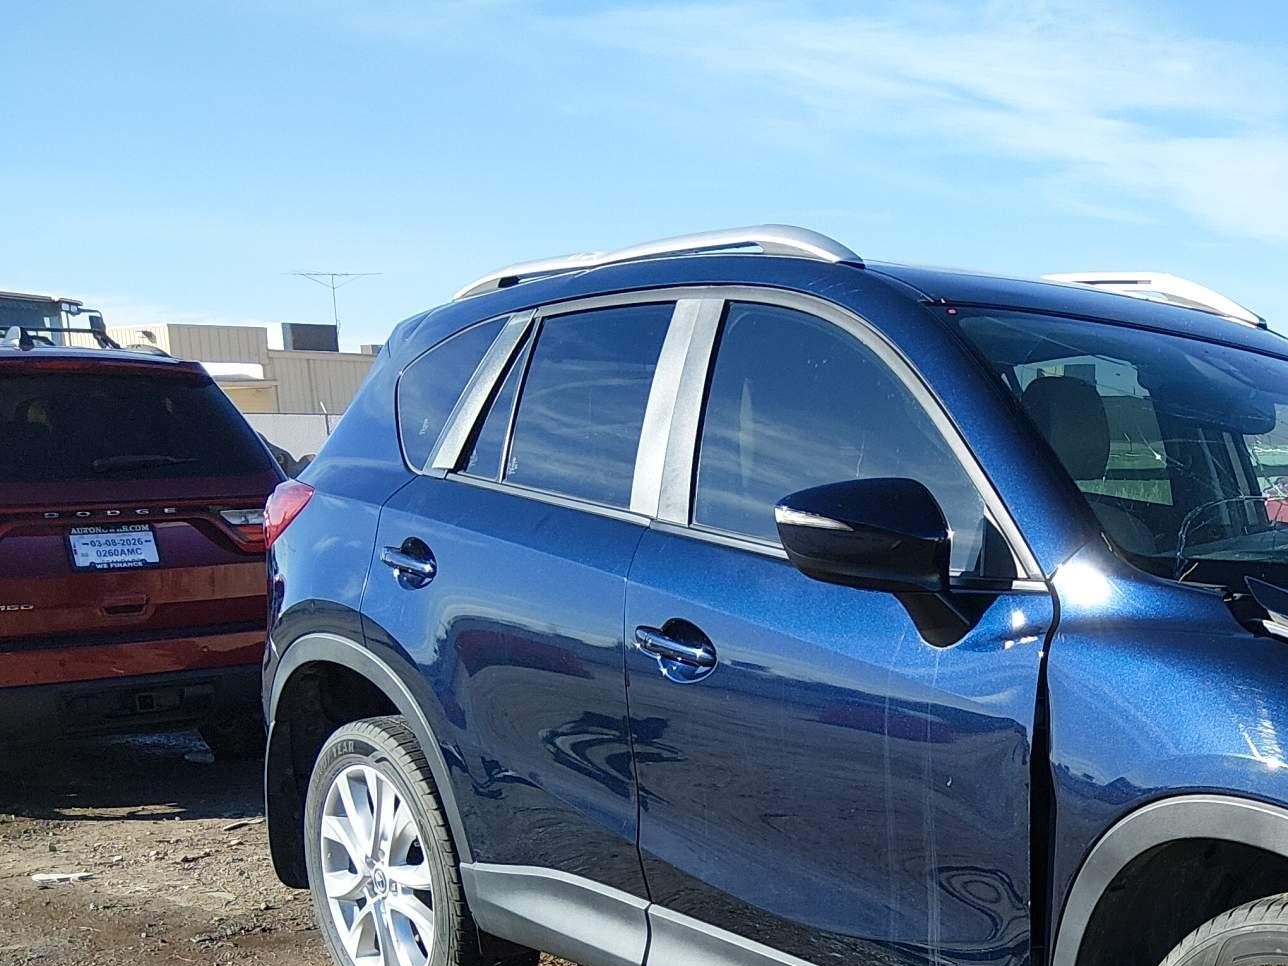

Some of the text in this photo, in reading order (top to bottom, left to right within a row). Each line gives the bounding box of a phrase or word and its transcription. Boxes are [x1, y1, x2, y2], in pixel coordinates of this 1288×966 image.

[44, 507, 176, 518] DODGE
[90, 538, 143, 548] 03-08-2026
[96, 547, 143, 557] 0260AMC
[110, 560, 144, 568] FINANCE
